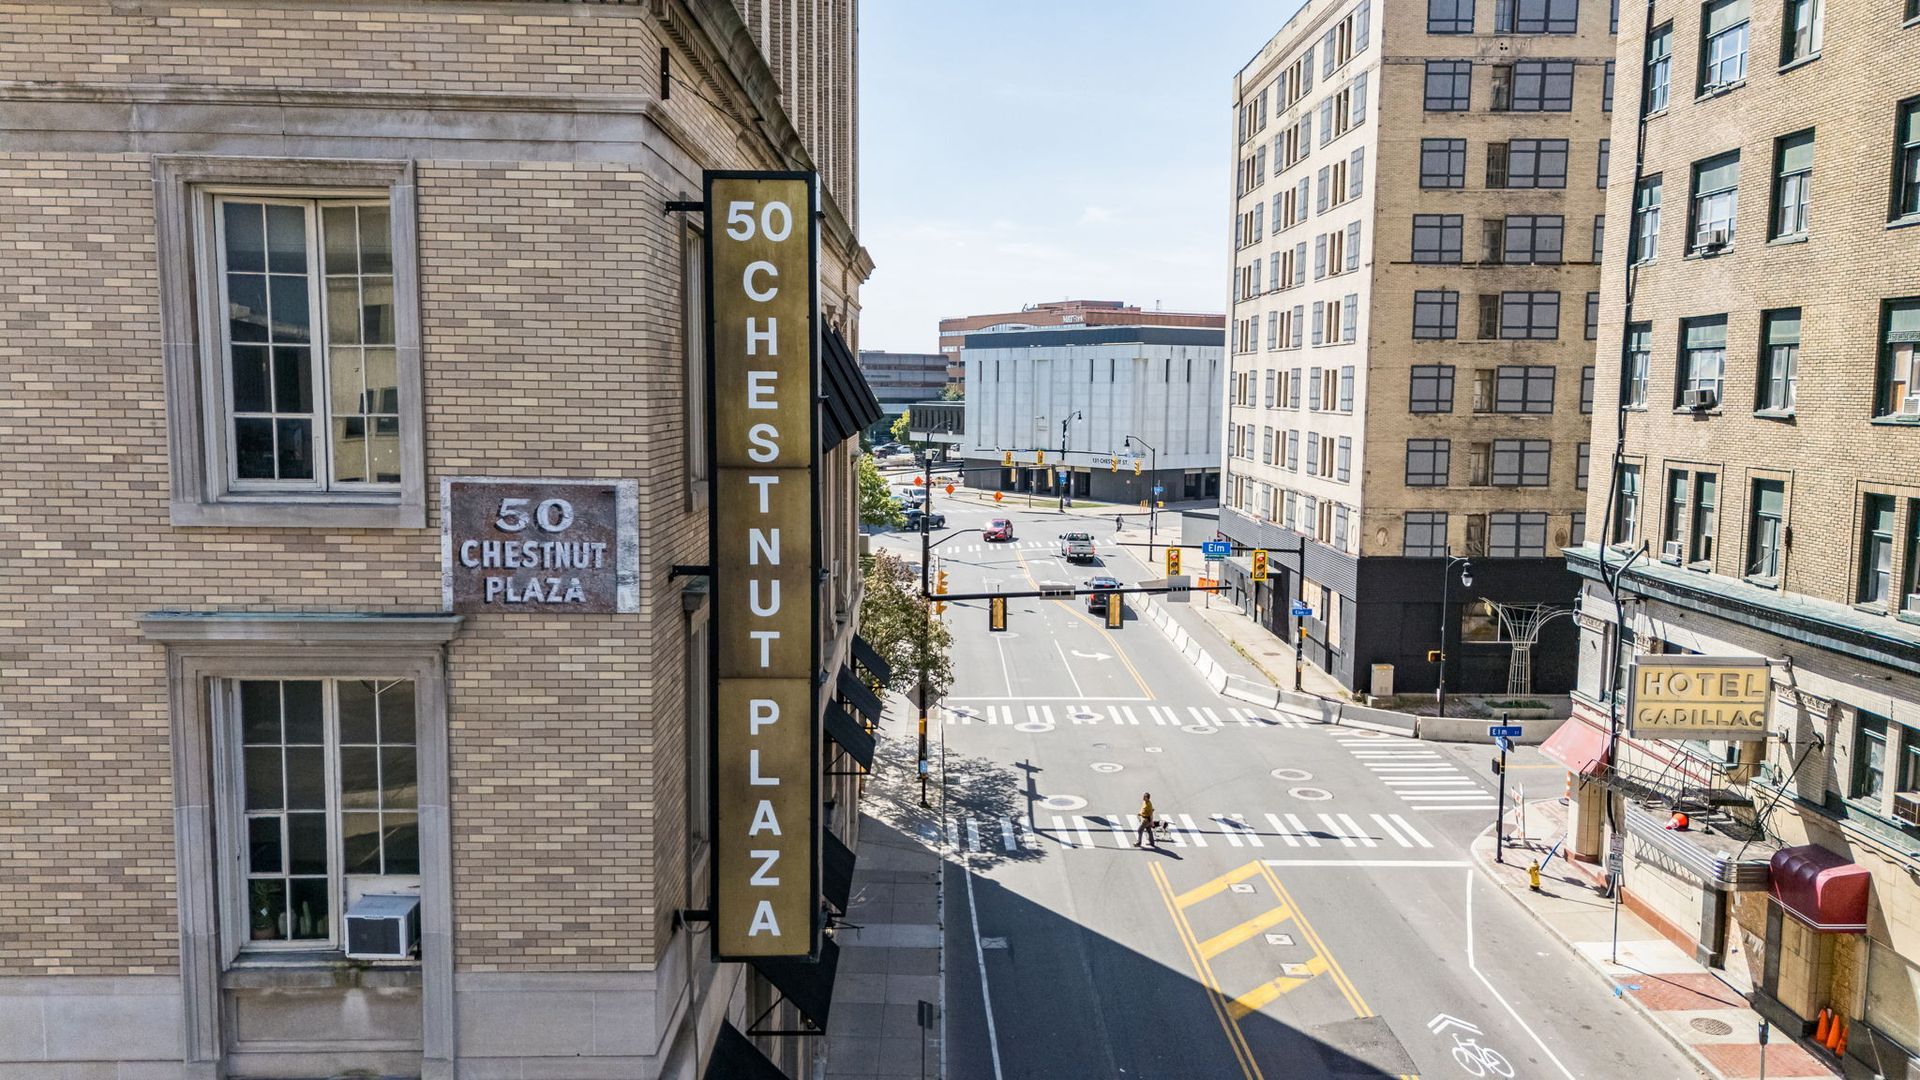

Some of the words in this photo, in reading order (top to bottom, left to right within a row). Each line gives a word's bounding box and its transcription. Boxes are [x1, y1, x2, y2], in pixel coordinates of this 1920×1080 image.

[726, 201, 792, 242] 50
[743, 260, 781, 667] CHESTNUT
[496, 498, 574, 532] 50
[460, 540, 607, 569] CHESTNUT
[1208, 543, 1225, 552] Elm
[485, 577, 587, 604] PLAZA
[1644, 672, 1764, 697] HOTEL
[1639, 708, 1764, 726] CADILLAC
[1492, 728, 1508, 736] Elm
[748, 699, 782, 936] PLAZA
